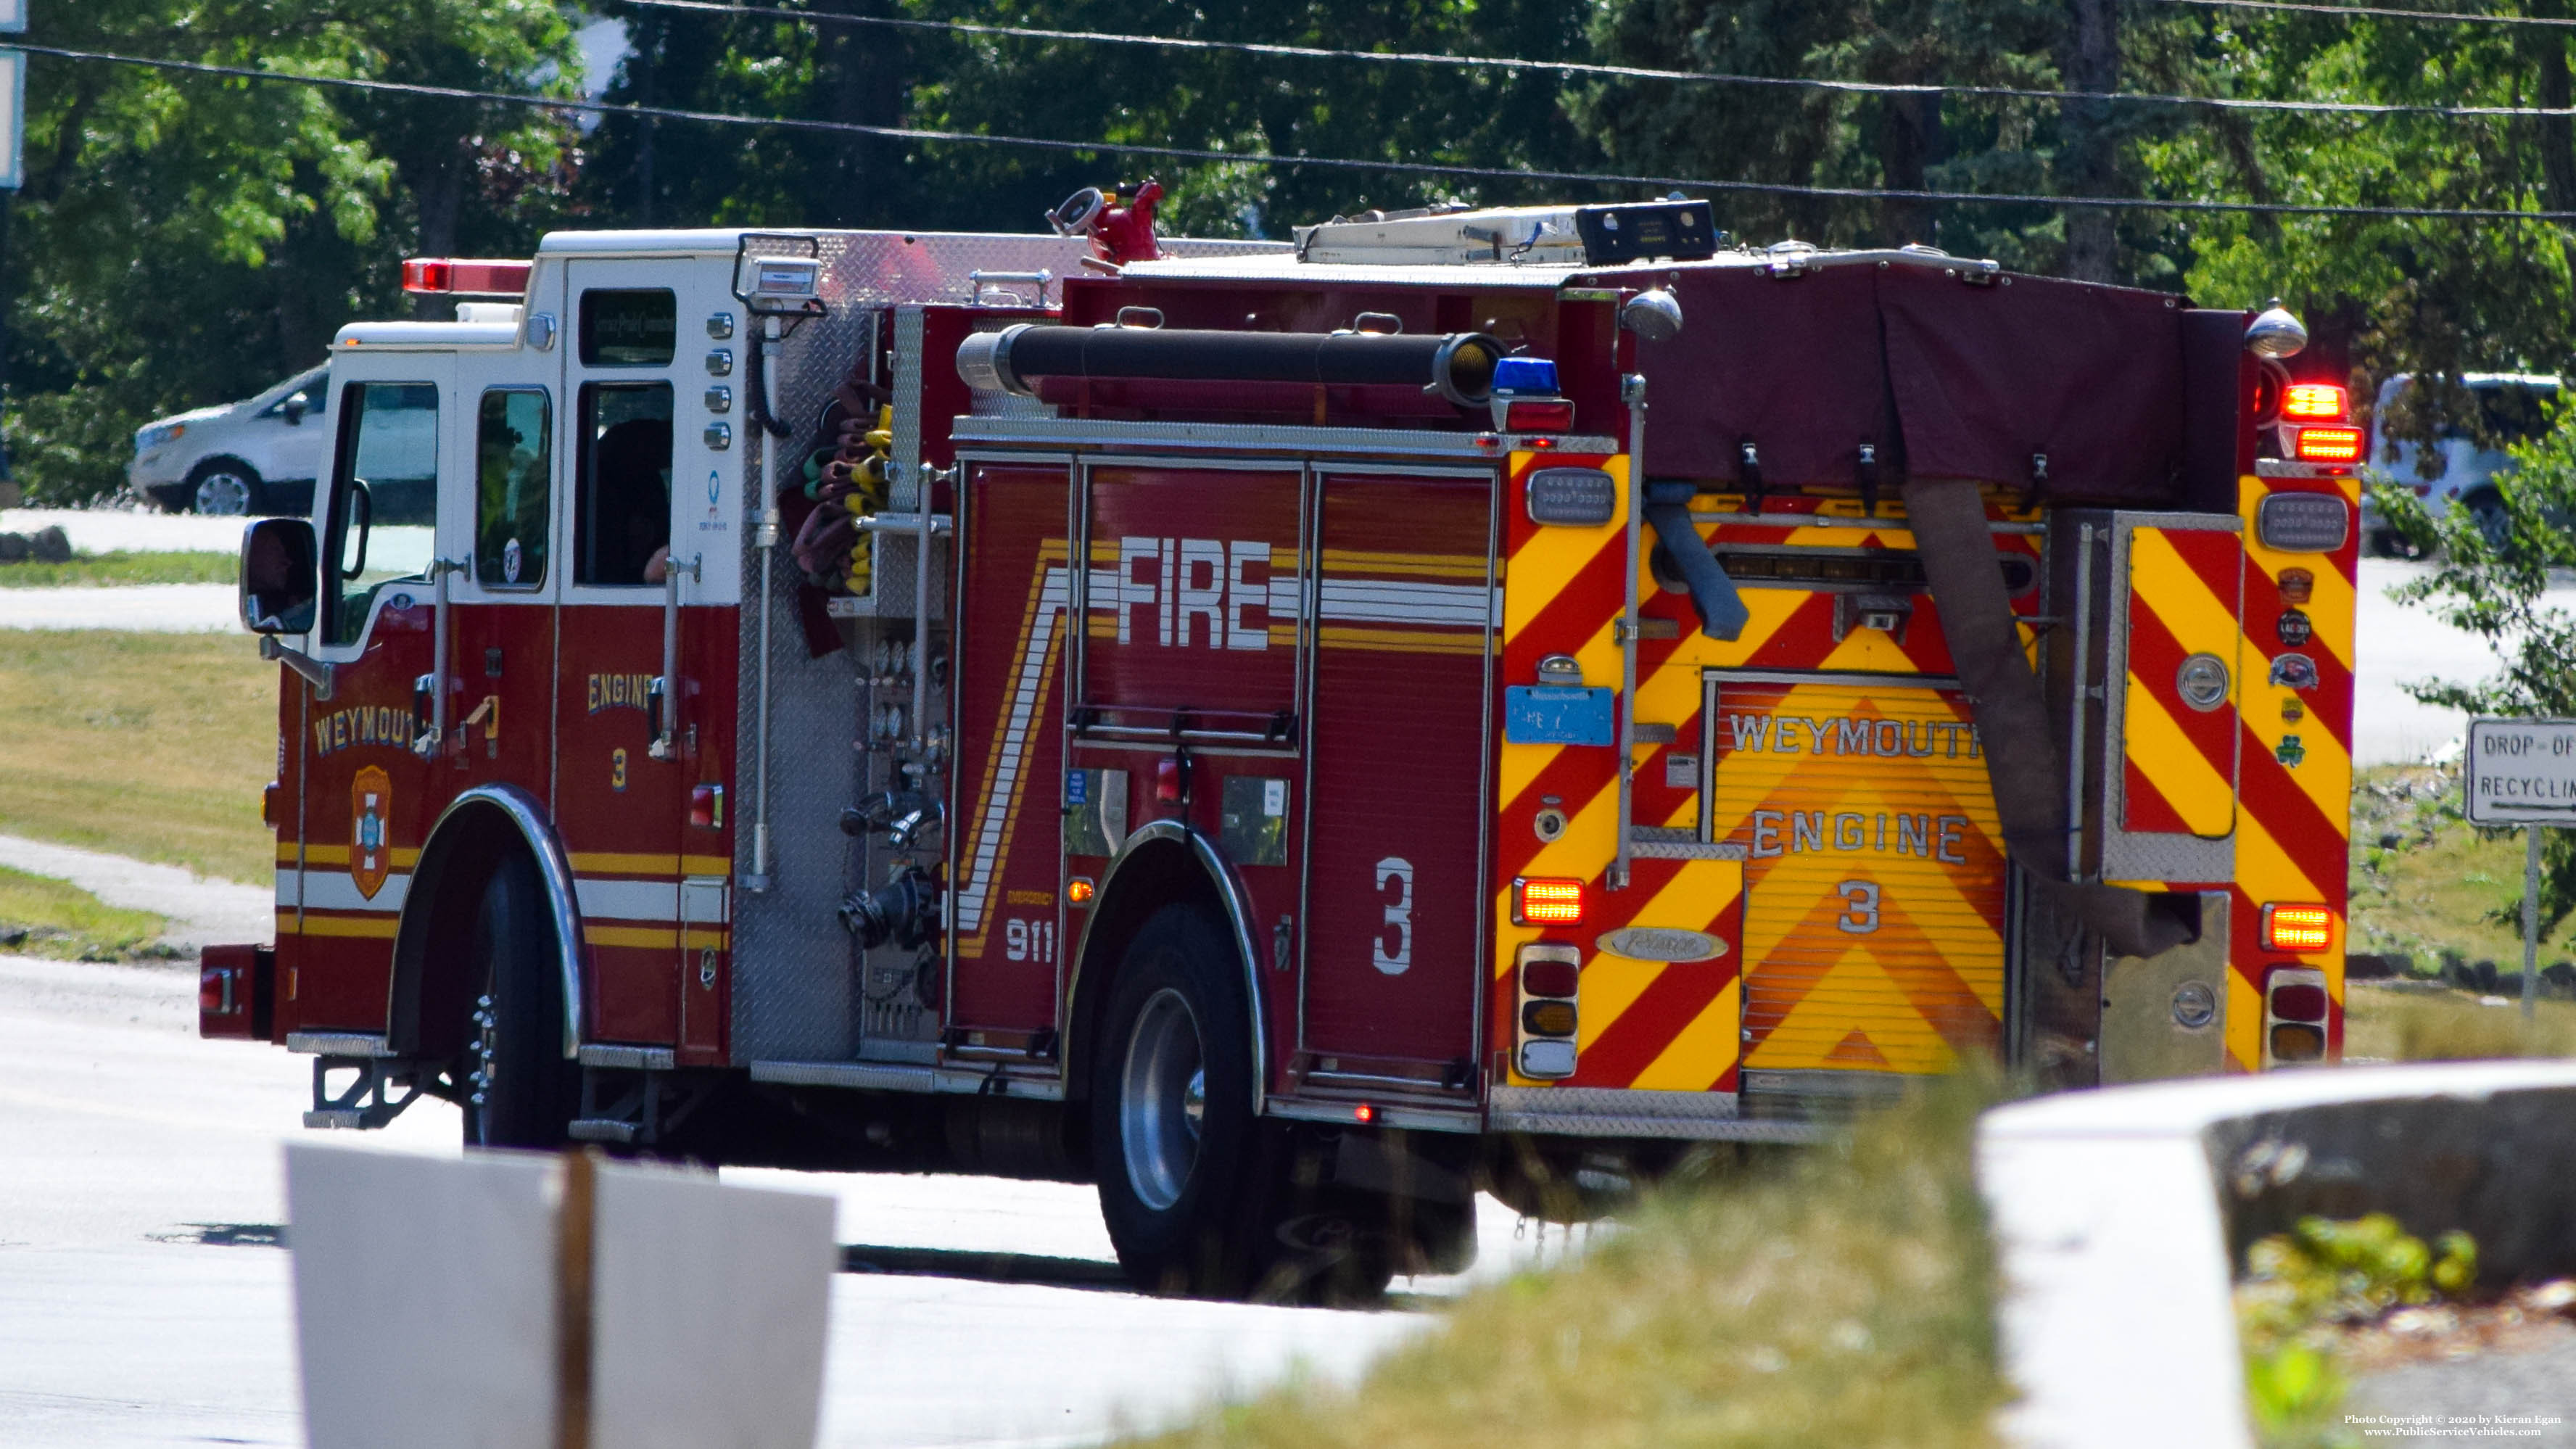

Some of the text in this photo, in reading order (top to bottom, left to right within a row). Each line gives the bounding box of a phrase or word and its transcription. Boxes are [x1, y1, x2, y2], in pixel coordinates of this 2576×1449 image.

[1118, 536, 1271, 651] FIRE
[314, 706, 426, 757] WEYMOUT
[611, 748, 627, 791] 3
[1752, 809, 1968, 865] ENGINE
[1373, 856, 1413, 975] 3
[1837, 878, 1881, 934] 3
[1007, 918, 1053, 963] 911
